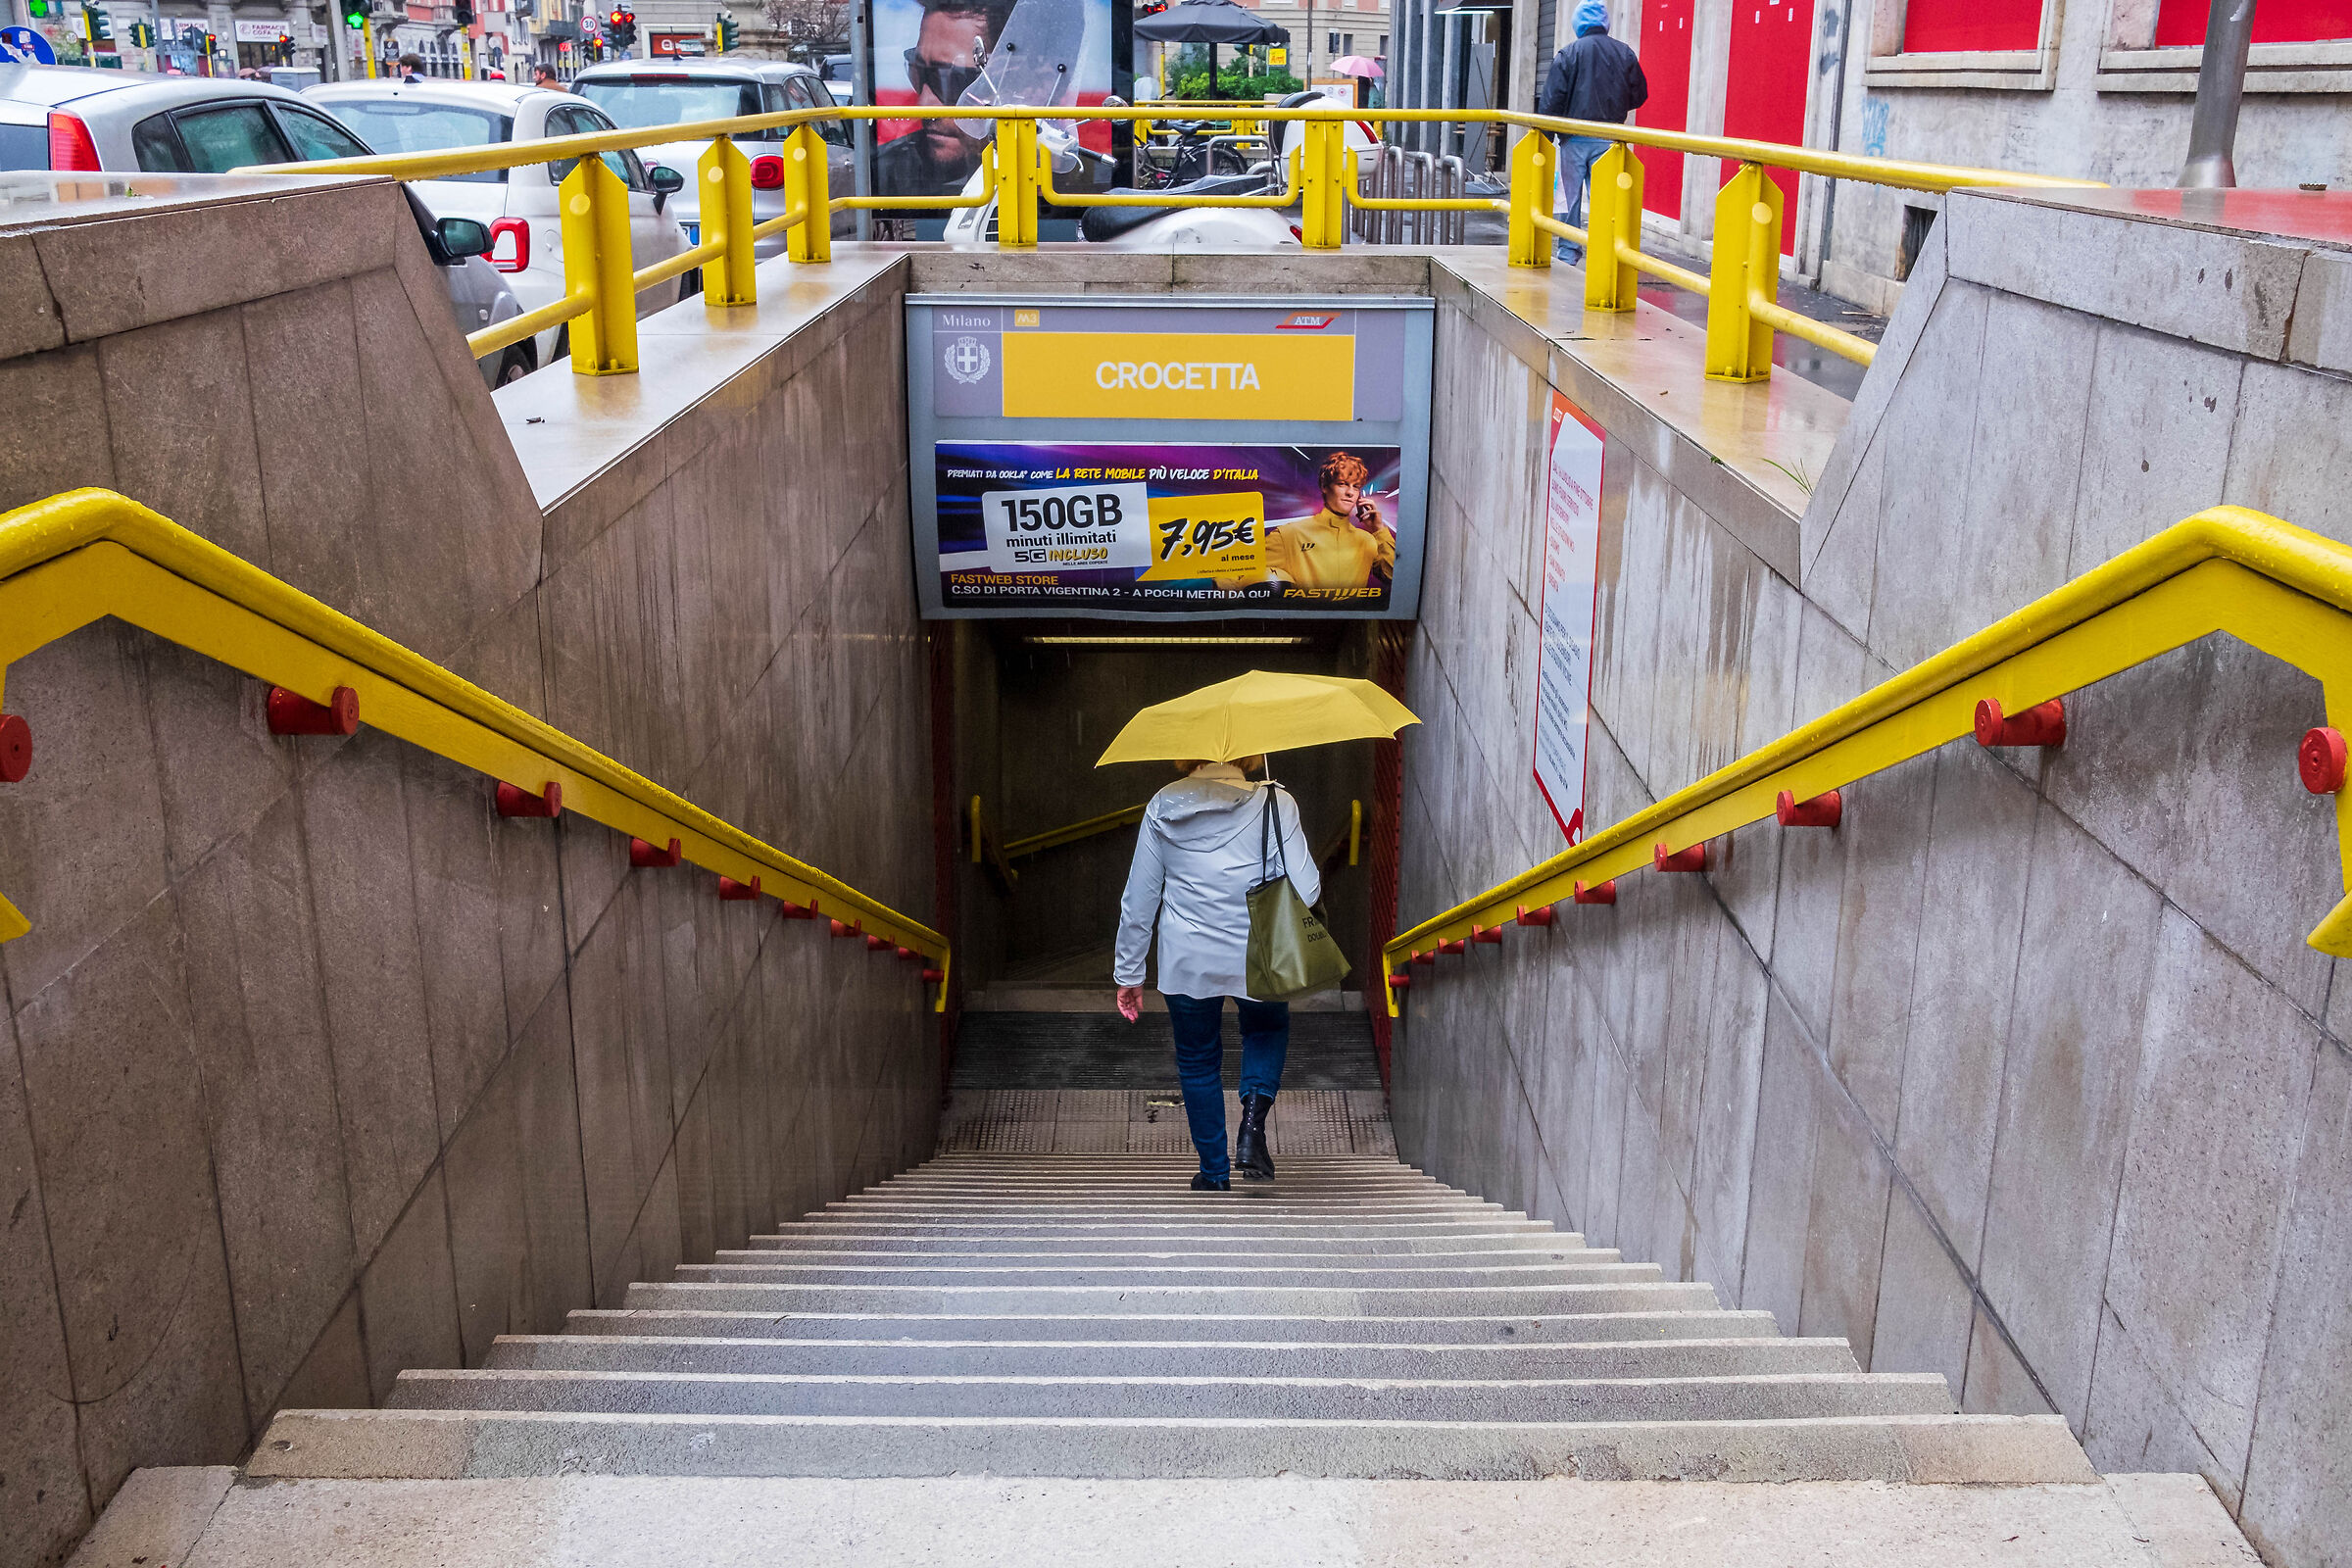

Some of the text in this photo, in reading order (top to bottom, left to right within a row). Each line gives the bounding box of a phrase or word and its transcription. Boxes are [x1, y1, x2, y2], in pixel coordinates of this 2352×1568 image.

[942, 314, 991, 327] Milano
[1016, 313, 1037, 323] M3
[1294, 317, 1321, 326] ATM
[1096, 362, 1260, 390] CROCETTA
[947, 469, 983, 478] PREMIATI
[986, 470, 997, 479] DA
[1030, 470, 1054, 479] COME
[1055, 467, 1070, 479] LA
[1074, 467, 1102, 479] RETE
[1104, 467, 1146, 480] MOBILE
[1149, 466, 1167, 480] PIÙ
[1169, 468, 1209, 480] VELOCE
[1212, 468, 1259, 480] D'ITALIA
[1001, 493, 1123, 532] 150GB
[1006, 530, 1116, 548] minuti illimitati
[1159, 517, 1255, 561] 7,95€
[1014, 547, 1108, 563] 5G INCLUSO
[1221, 554, 1229, 563] al
[951, 574, 1058, 586] FASTWEB STORE
[952, 585, 981, 595] C.SO
[985, 586, 996, 595] DI
[1000, 586, 1041, 595] PORTA
[1043, 586, 1110, 597] VIGENTINA
[1112, 588, 1121, 597] 2
[1132, 588, 1142, 597] A
[1145, 588, 1183, 598] POCHI
[1186, 590, 1225, 599] METRI
[1228, 590, 1246, 599] DA
[1283, 588, 1382, 601] FASTWEB
